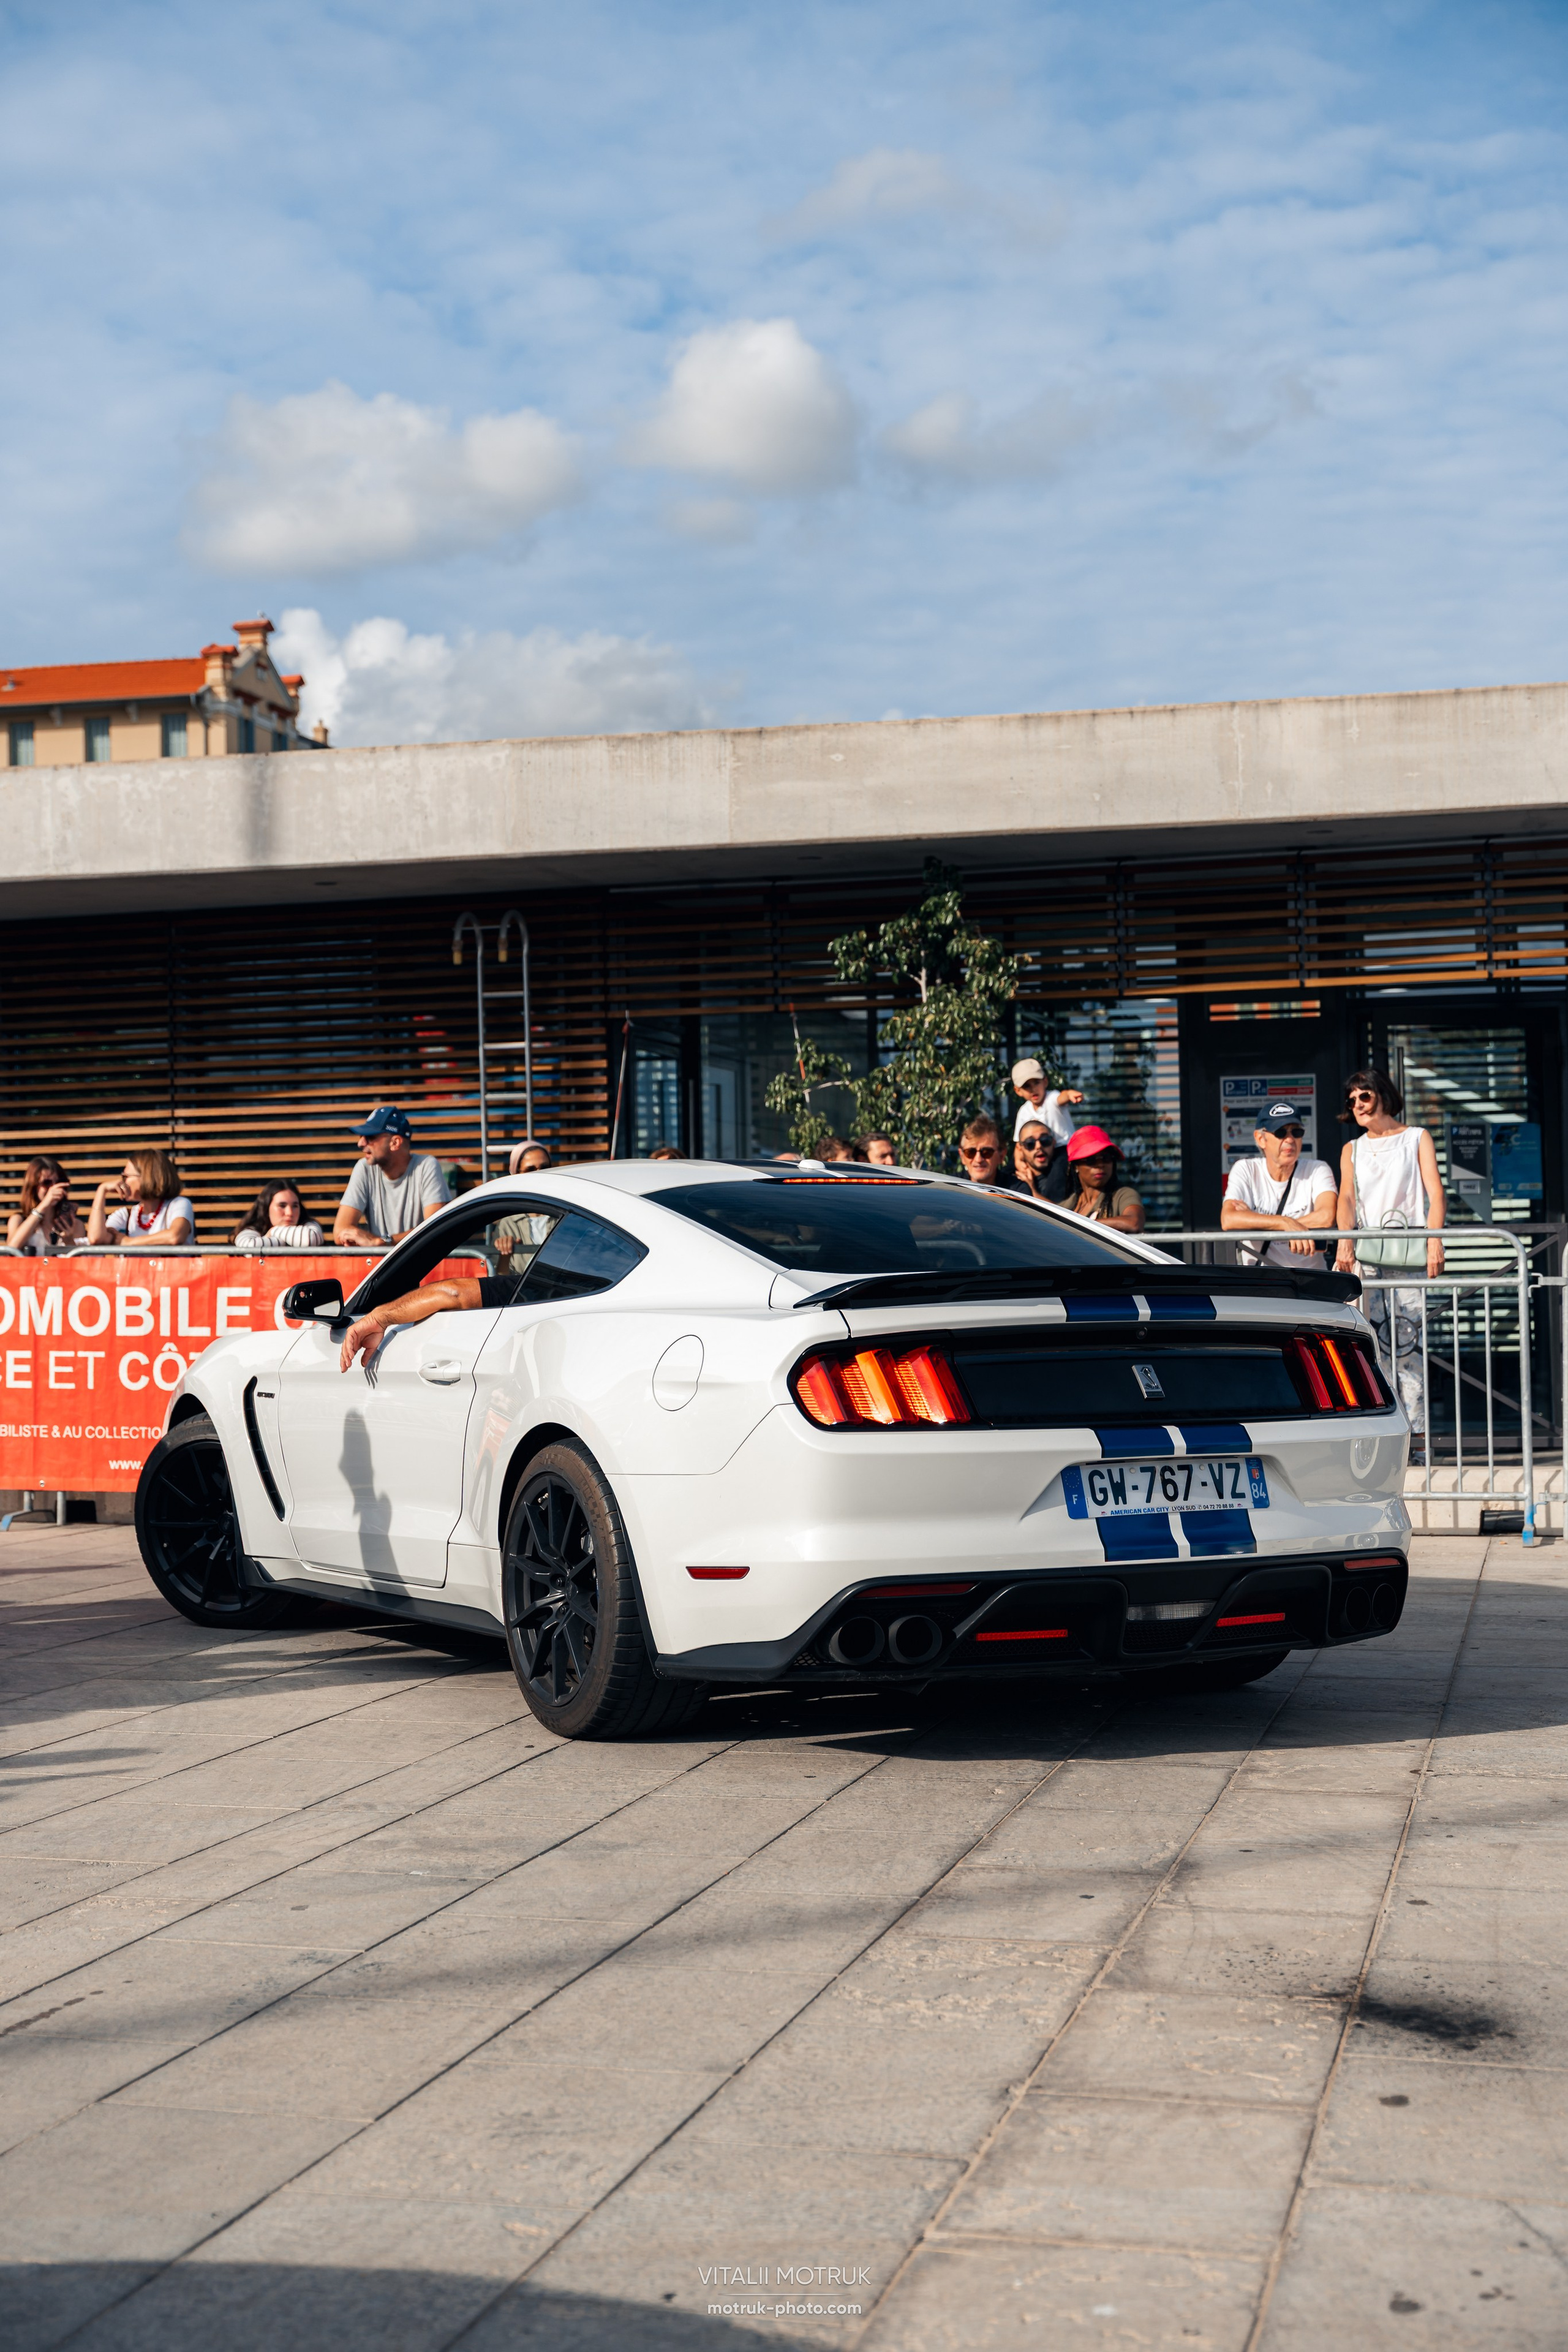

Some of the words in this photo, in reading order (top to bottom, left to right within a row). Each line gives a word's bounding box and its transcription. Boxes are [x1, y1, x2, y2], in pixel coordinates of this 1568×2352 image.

[0, 1350, 32, 1389] E
[48, 1351, 105, 1390] ET
[118, 1342, 202, 1392] CÔ
[0, 1424, 48, 1438] BILISTE
[51, 1425, 61, 1438] &
[62, 1425, 82, 1438] AU
[108, 1460, 143, 1470] www.
[1088, 1462, 1246, 1507] GW-767-VZ
[1251, 1482, 1267, 1499] 84
[1072, 1494, 1078, 1504] F
